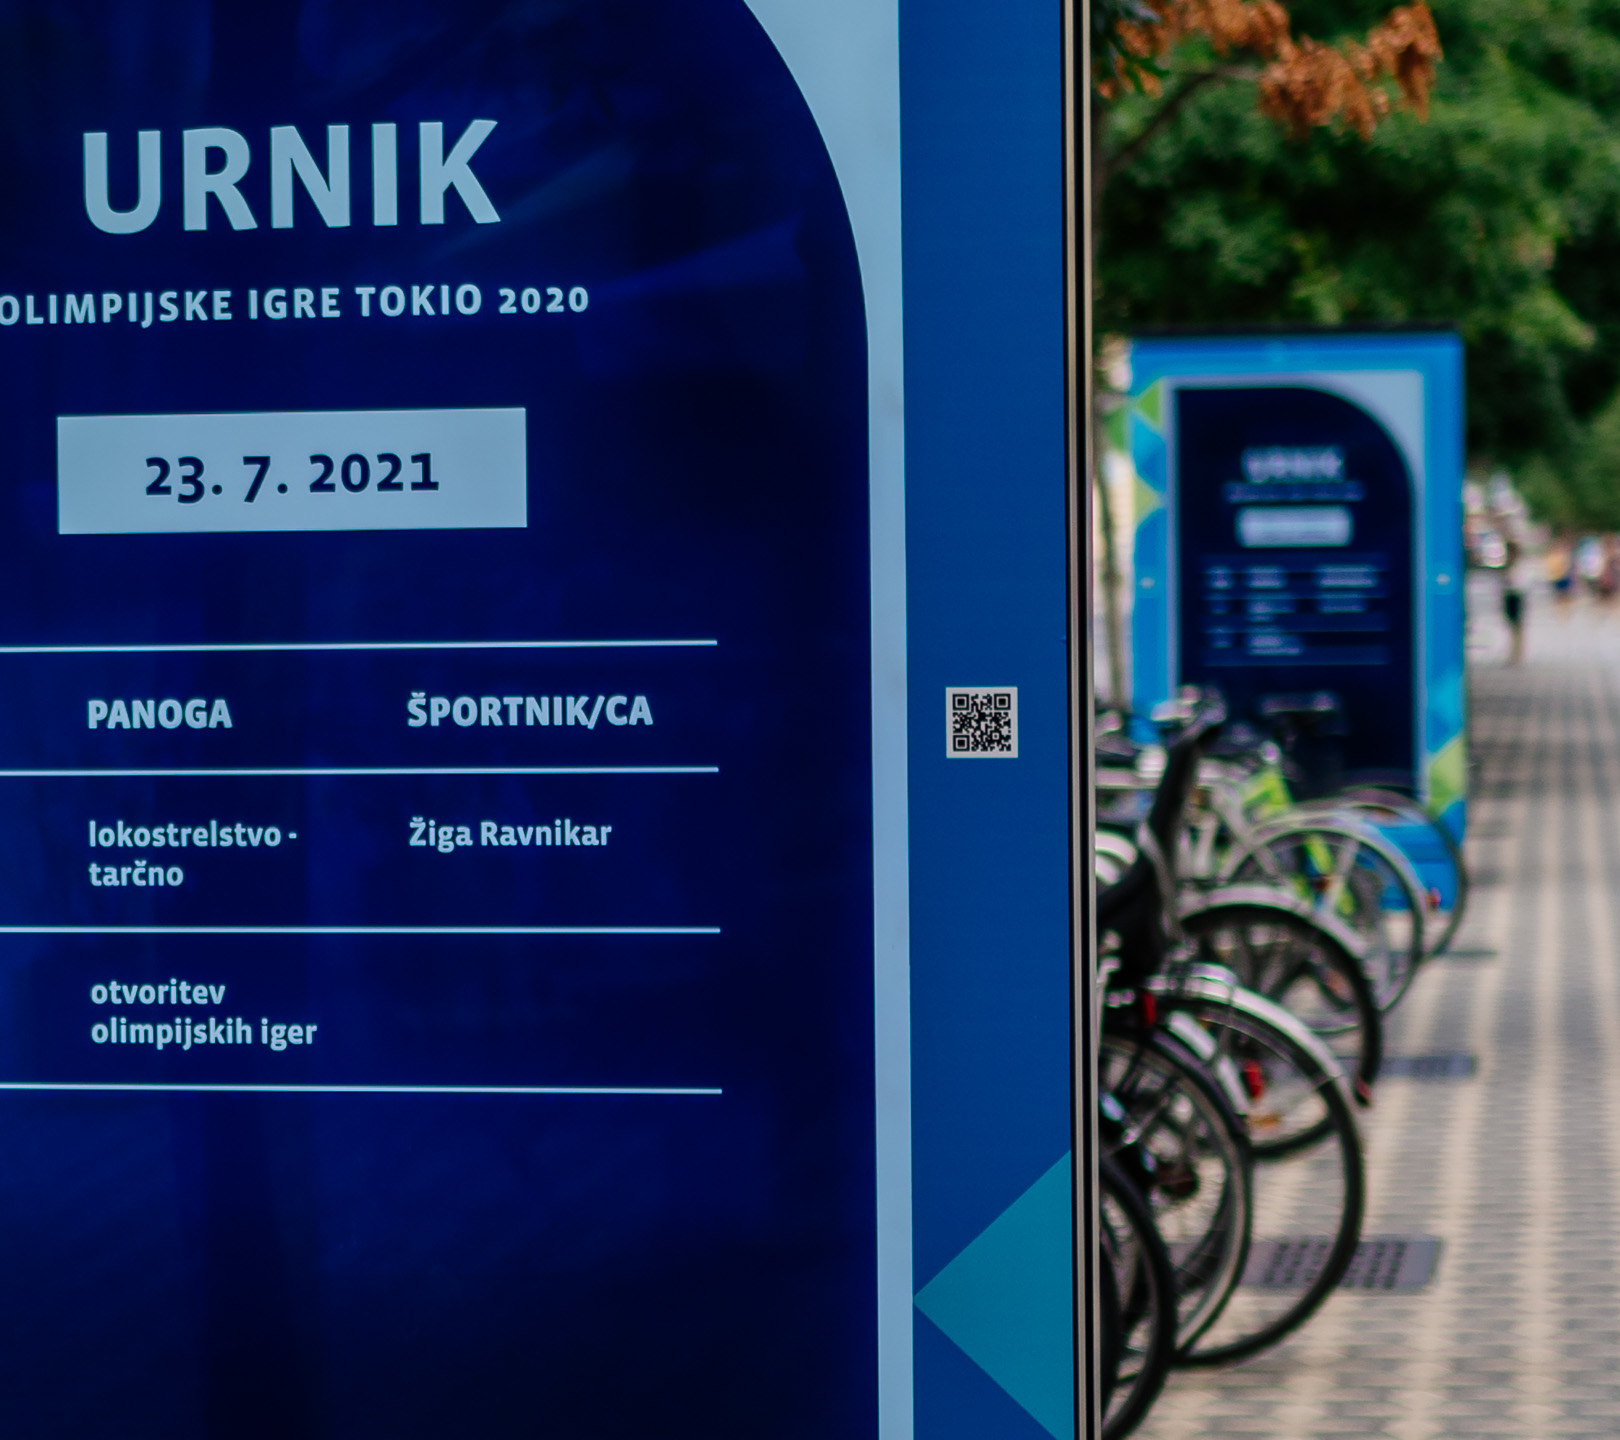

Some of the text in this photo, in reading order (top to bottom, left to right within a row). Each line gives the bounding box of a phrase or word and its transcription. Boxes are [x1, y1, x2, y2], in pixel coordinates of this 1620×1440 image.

[83, 119, 502, 235] URNIK
[248, 286, 342, 320] IGRE
[354, 283, 483, 318] TOKIO
[498, 286, 589, 315] 2020
[146, 453, 439, 504] 23. 7. 2021
[88, 697, 233, 730] PANOGA
[407, 690, 654, 731] ŠPORTNIK/CA
[88, 819, 282, 848] lokostrelstvo
[408, 816, 613, 853] Žiga Ravnikar
[88, 859, 184, 887] tarčno
[90, 978, 226, 1005] otvoritev
[90, 1015, 318, 1051] olimpijskih iger
